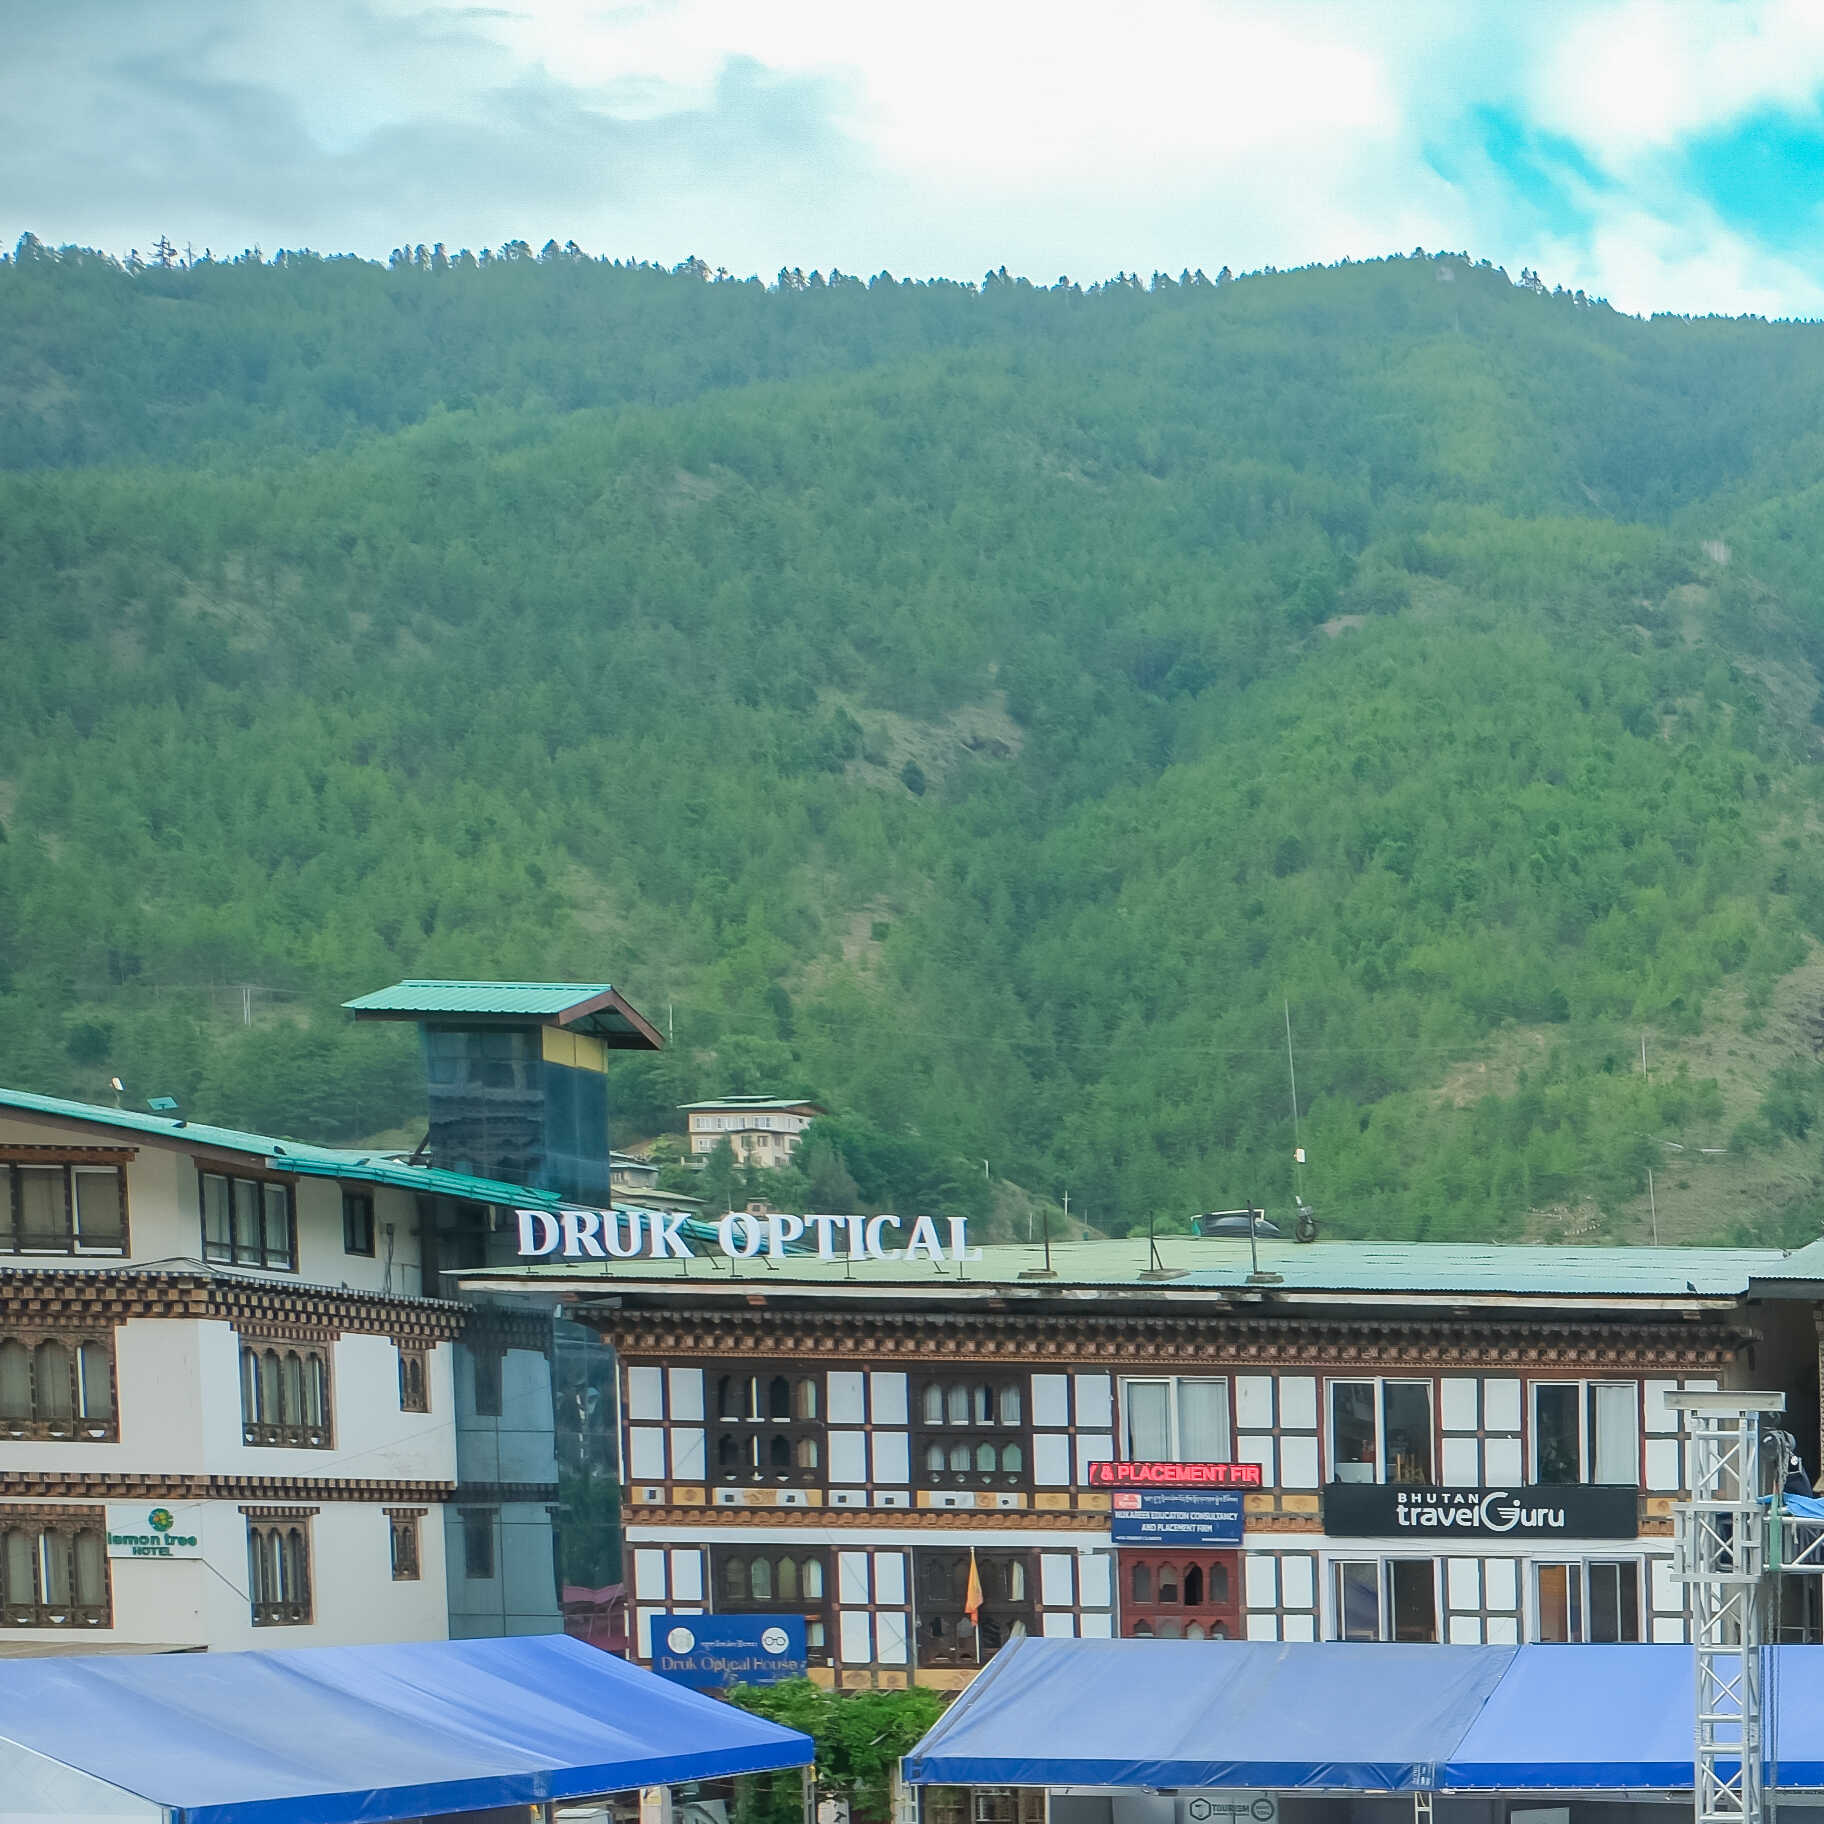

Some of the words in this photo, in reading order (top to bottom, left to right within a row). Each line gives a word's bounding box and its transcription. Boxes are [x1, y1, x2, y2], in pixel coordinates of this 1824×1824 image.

[514, 1209, 695, 1258] DRUK
[717, 1212, 983, 1262] OPTICAL
[1100, 1464, 1114, 1481] &
[1118, 1464, 1227, 1482] PLACEMENT
[1398, 1493, 1479, 1504] BHUTAN
[107, 1531, 161, 1545] lemon
[164, 1533, 197, 1546] tree
[132, 1546, 174, 1556] HOTEL
[662, 1656, 697, 1671] Druk
[753, 1656, 797, 1671] House
